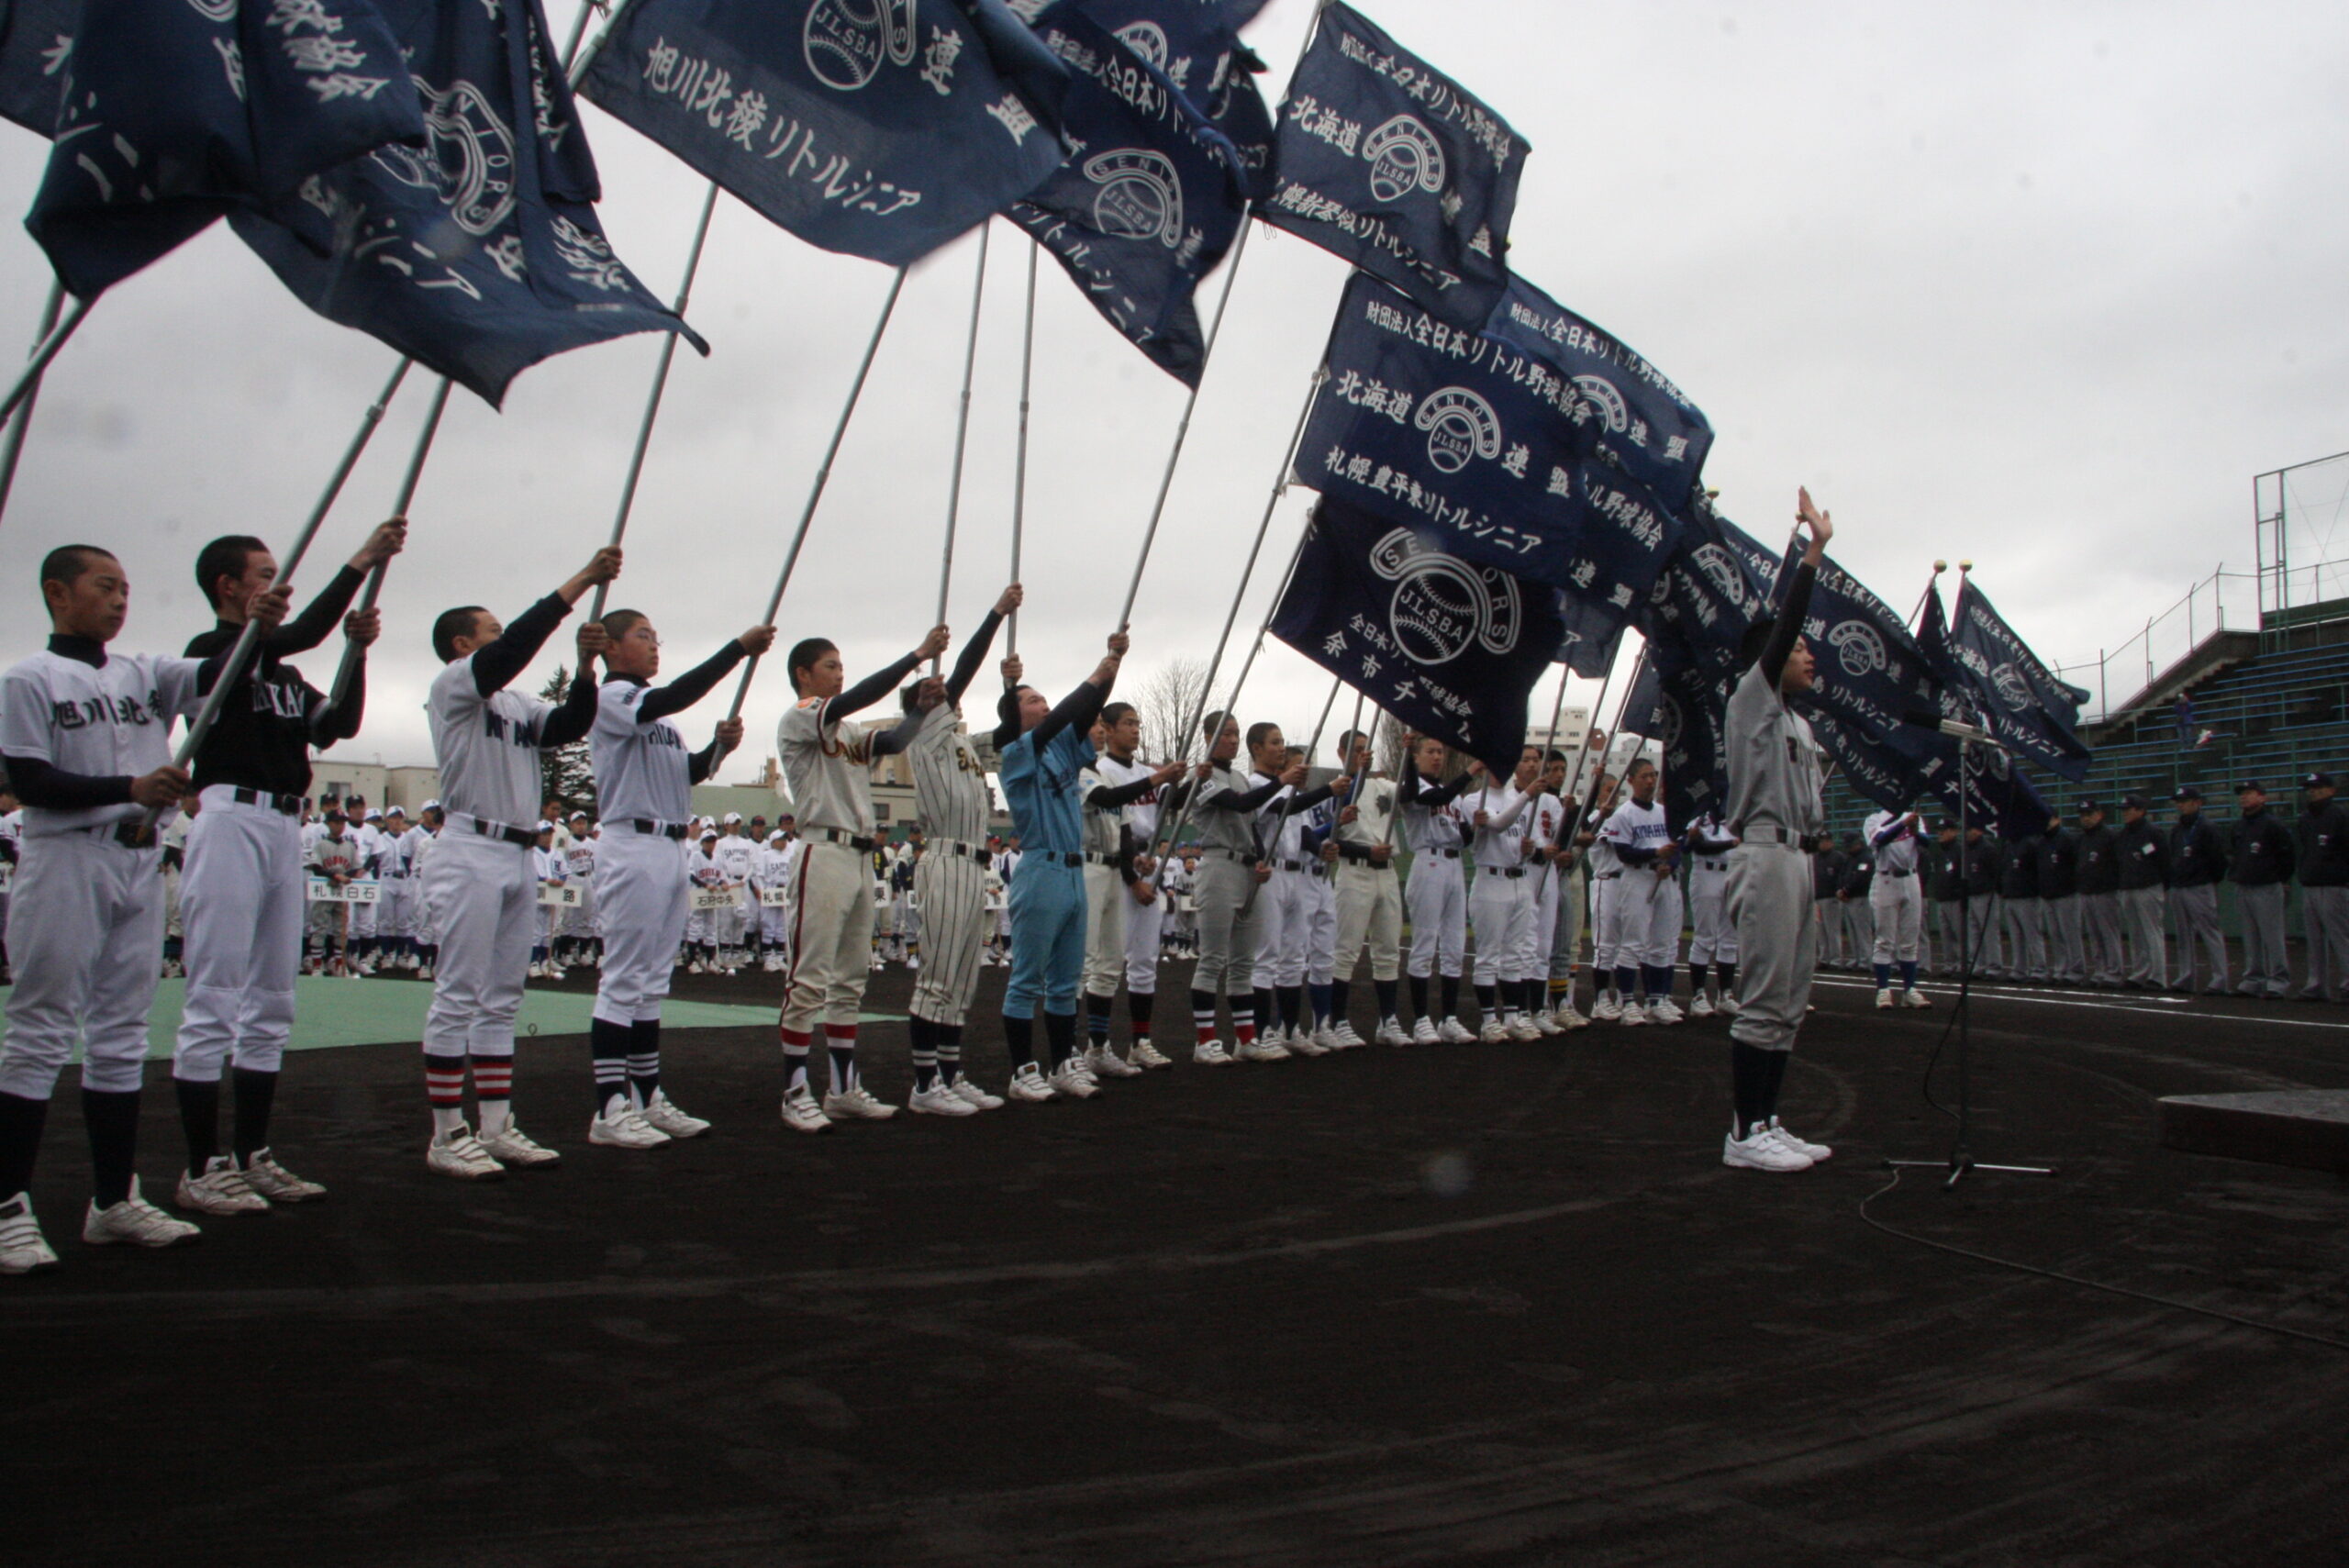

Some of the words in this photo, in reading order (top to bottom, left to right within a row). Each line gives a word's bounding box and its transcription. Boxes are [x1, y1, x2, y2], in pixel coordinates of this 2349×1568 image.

[815, 7, 877, 61] JLSBA
[1289, 95, 1361, 158] 北海道
[1364, 122, 1439, 183] SENIORS
[1375, 160, 1412, 185] JLSBA
[1364, 300, 1593, 428] 財団法人全日本リトル野球協会
[1336, 369, 1413, 425] 北海道
[1422, 394, 1495, 450] SENIORS
[1325, 444, 1542, 554] 札幌豊平東リトルシニア
[1384, 535, 1510, 638] SEORS
